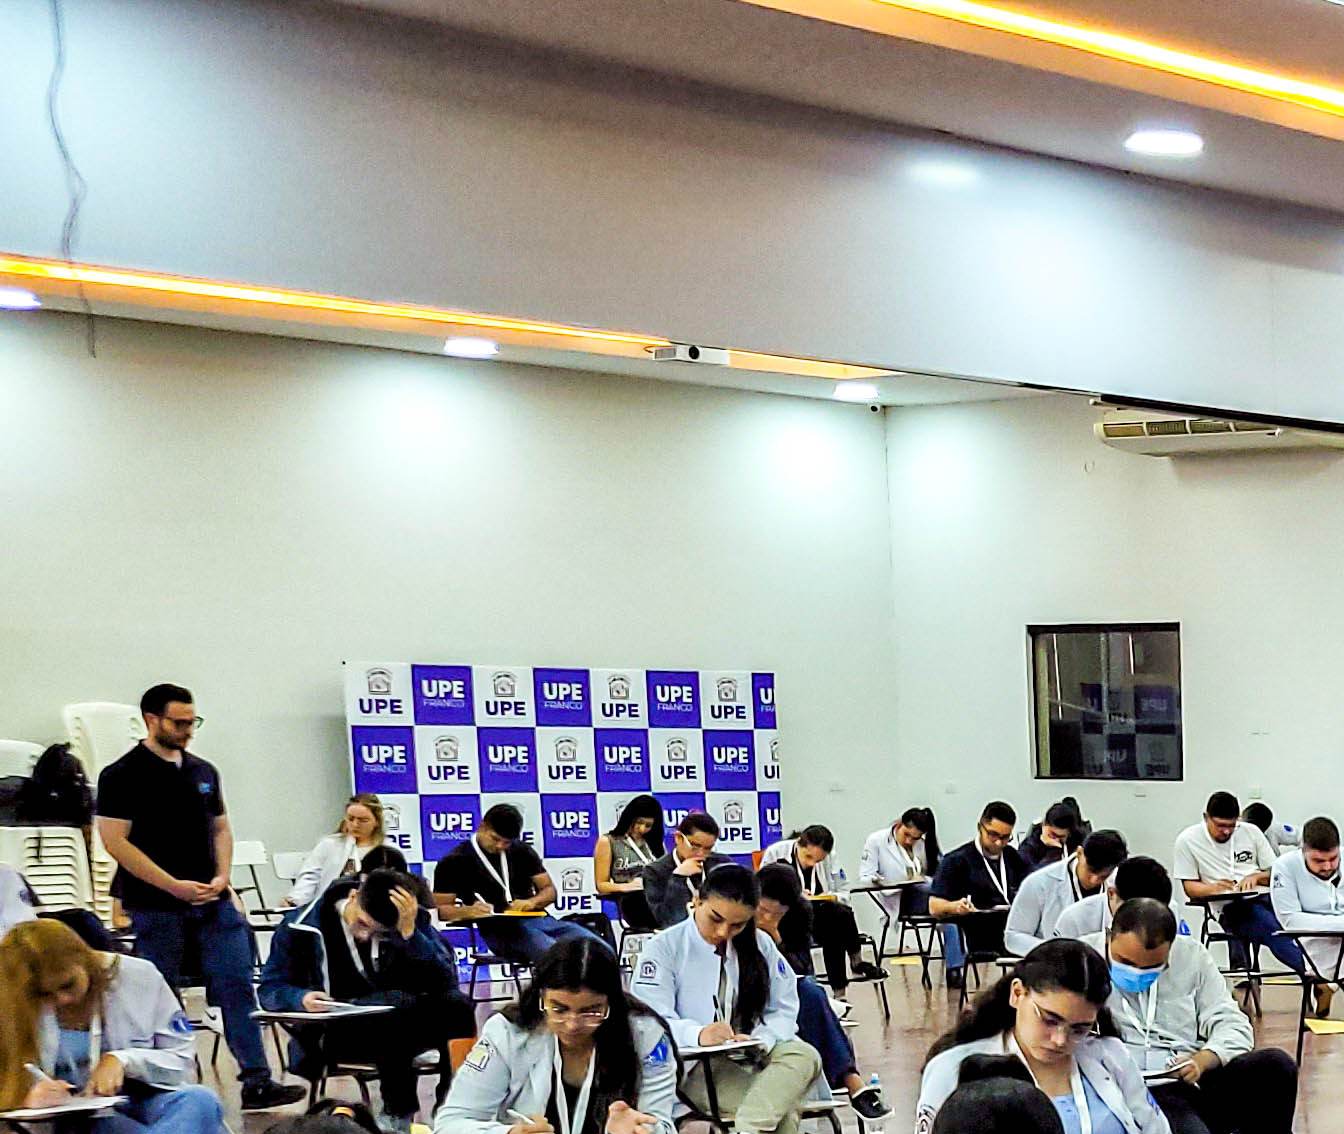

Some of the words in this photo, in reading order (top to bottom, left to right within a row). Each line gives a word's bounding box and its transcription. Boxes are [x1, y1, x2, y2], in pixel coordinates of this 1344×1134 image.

[421, 679, 465, 698] UPE
[543, 682, 583, 701] UPE
[656, 685, 693, 703] UPE
[359, 698, 403, 714] UPE
[485, 700, 526, 716] UPE
[601, 703, 640, 718] UPE
[710, 705, 747, 720] UPE
[361, 745, 407, 764] UPE
[488, 745, 529, 764] UPE
[604, 746, 642, 764] UPE
[713, 747, 749, 764] UPE
[428, 765, 470, 781] UPE
[548, 765, 587, 780] UPE
[660, 765, 697, 780] UPE
[430, 812, 473, 831] UPE
[550, 811, 590, 829] UPE
[663, 809, 689, 827] UP
[385, 834, 411, 849] PE
[554, 895, 592, 911] UPE
